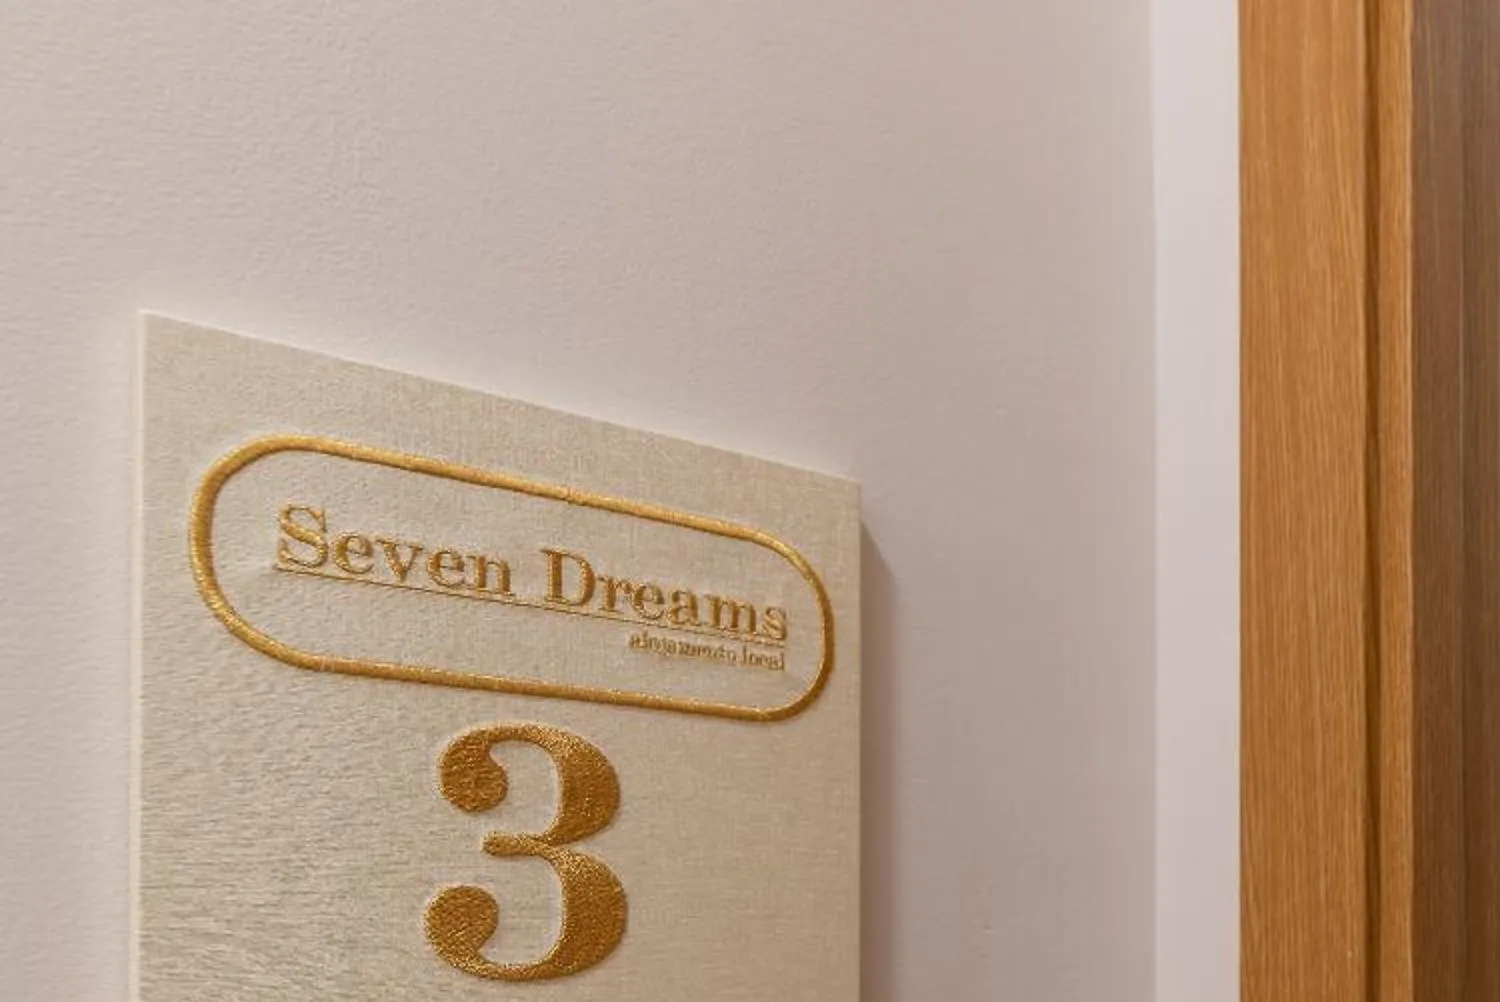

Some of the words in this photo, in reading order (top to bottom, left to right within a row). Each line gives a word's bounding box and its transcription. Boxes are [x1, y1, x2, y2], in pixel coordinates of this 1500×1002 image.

[276, 502, 515, 597] Seven
[540, 547, 789, 642] Dreams
[422, 722, 629, 982] 3
